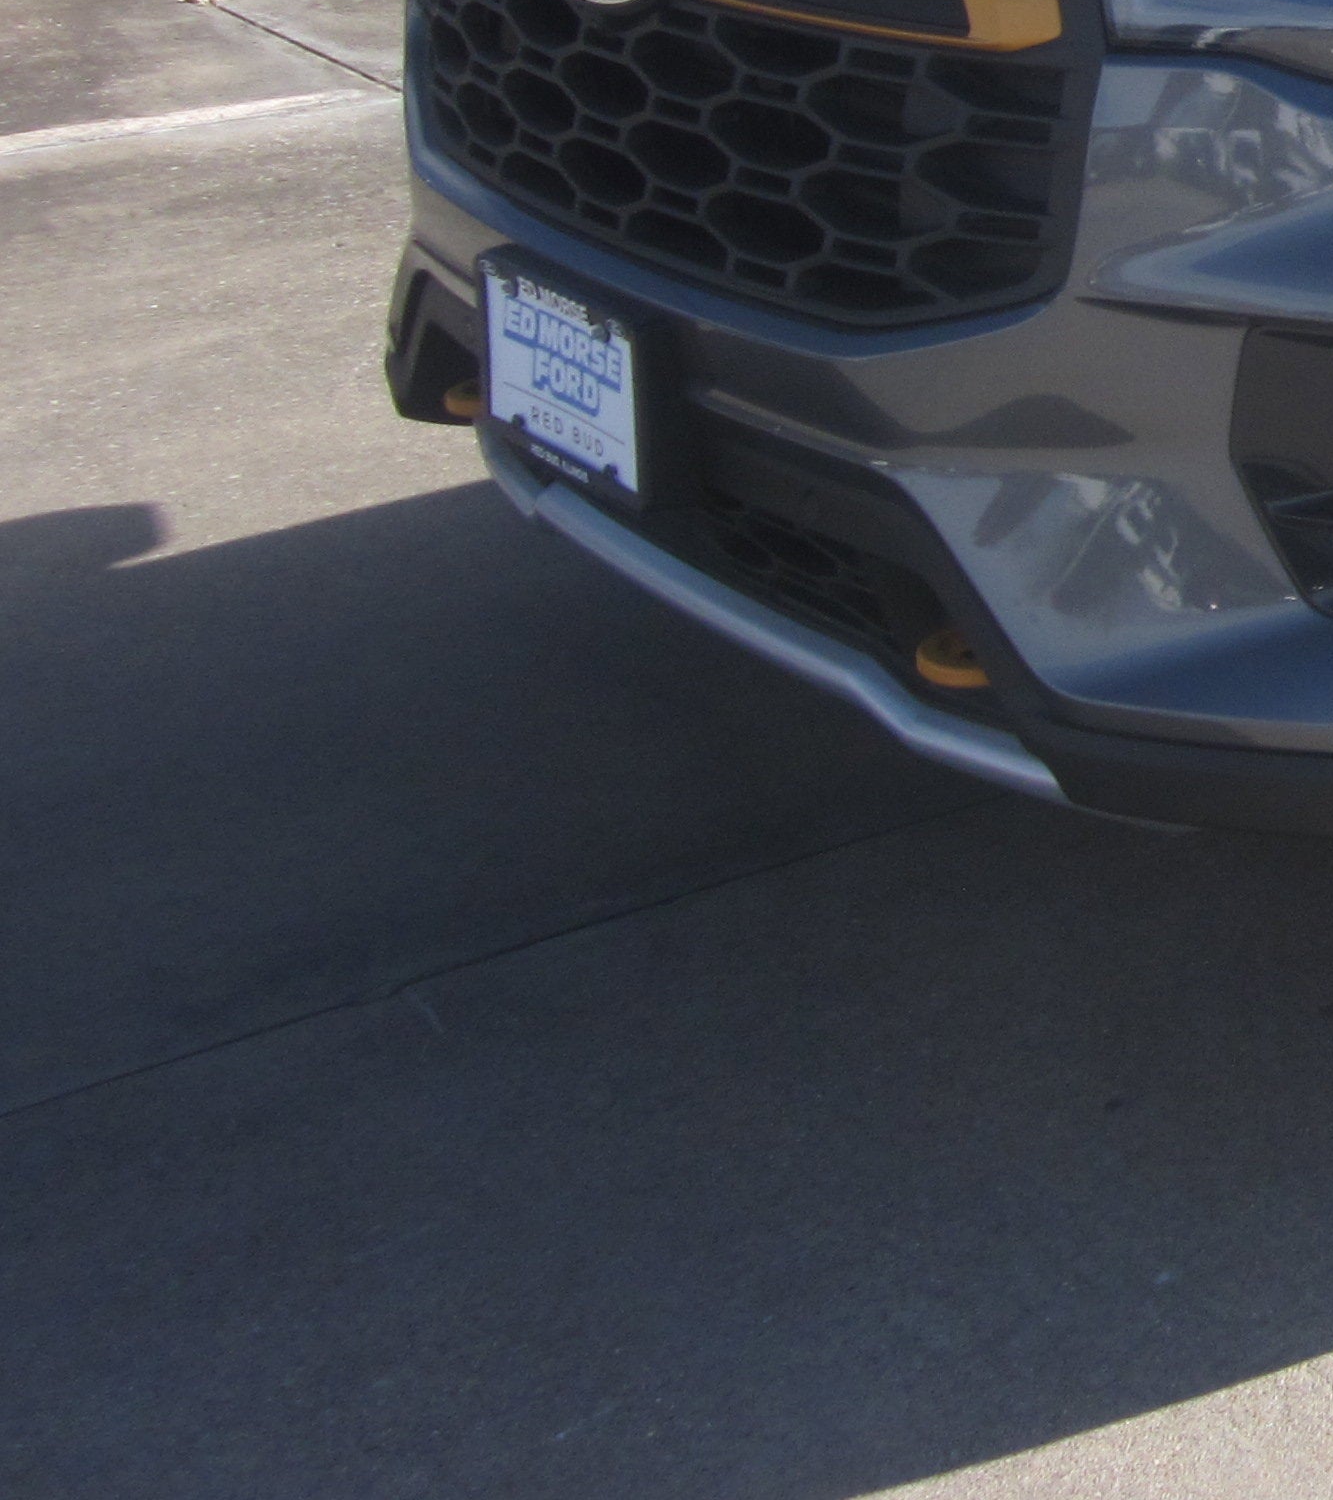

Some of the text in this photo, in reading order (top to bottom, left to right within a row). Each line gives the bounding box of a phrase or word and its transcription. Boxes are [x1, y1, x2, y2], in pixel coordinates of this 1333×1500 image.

[504, 297, 621, 390] ED MORSE
[533, 349, 600, 416] FORD
[530, 405, 604, 457] RED BUD
